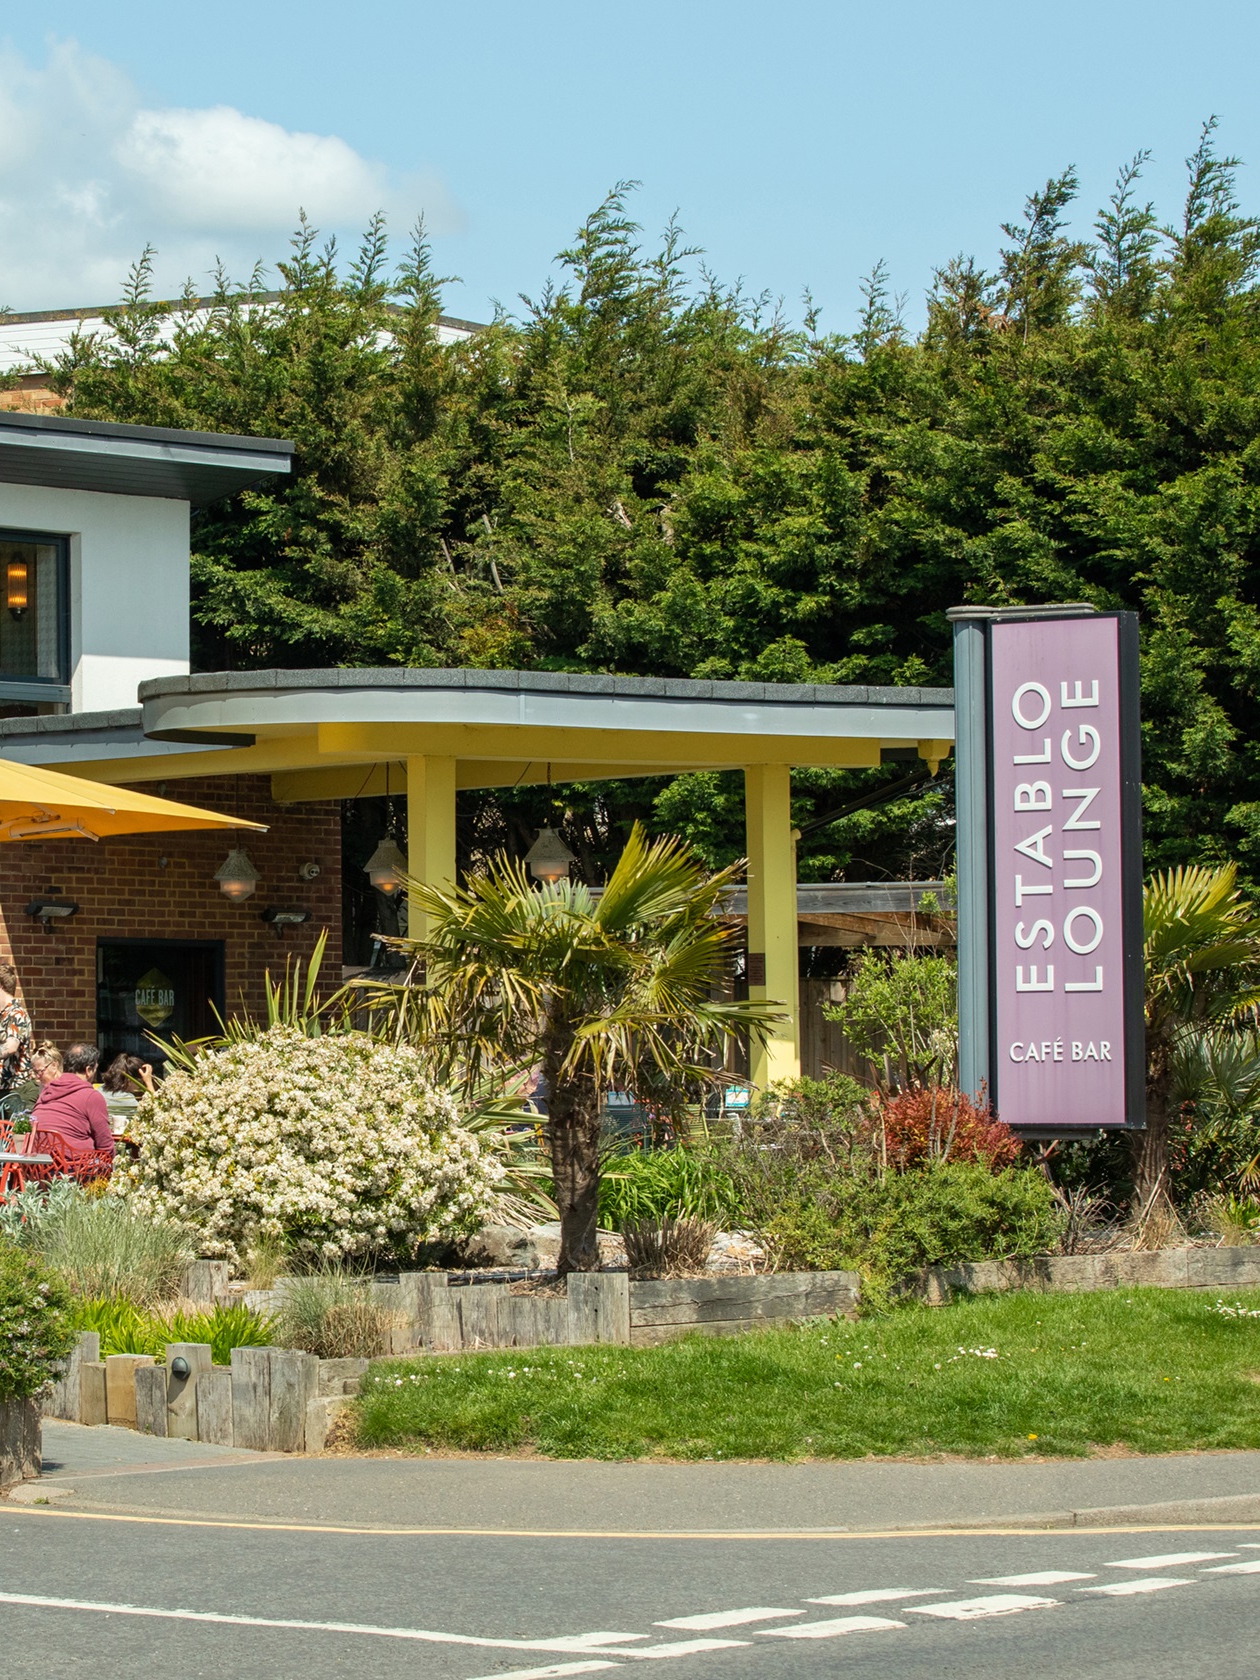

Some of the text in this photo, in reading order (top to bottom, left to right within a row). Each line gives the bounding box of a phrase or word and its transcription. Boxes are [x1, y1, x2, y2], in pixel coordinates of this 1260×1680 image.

[1011, 681, 1055, 993] ESTABLO
[1060, 679, 1104, 993] LOUNGE
[135, 985, 175, 1006] CAFÉ BAR
[1009, 1037, 1112, 1063] CAFÉ BAR
